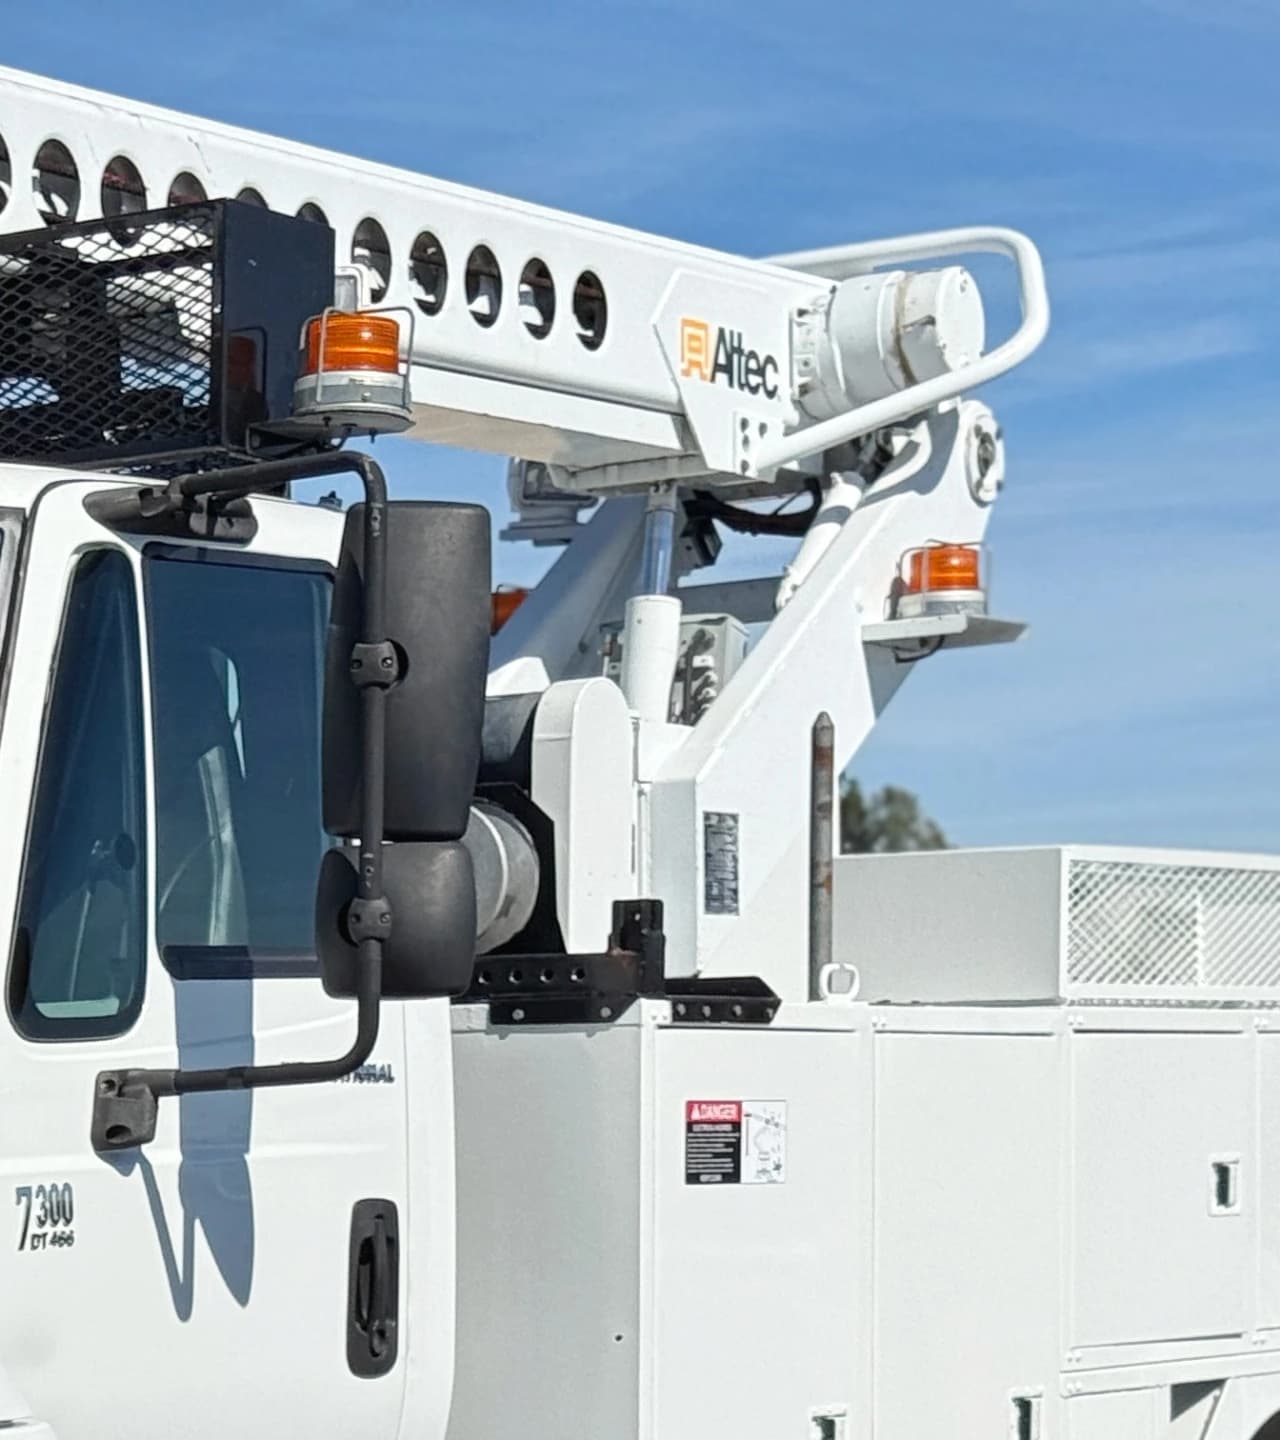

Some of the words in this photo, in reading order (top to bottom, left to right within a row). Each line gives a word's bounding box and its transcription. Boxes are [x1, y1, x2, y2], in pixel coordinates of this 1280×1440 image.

[710, 326, 779, 400] Altec
[30, 1232, 48, 1251] DT
[49, 1229, 75, 1248] 466
